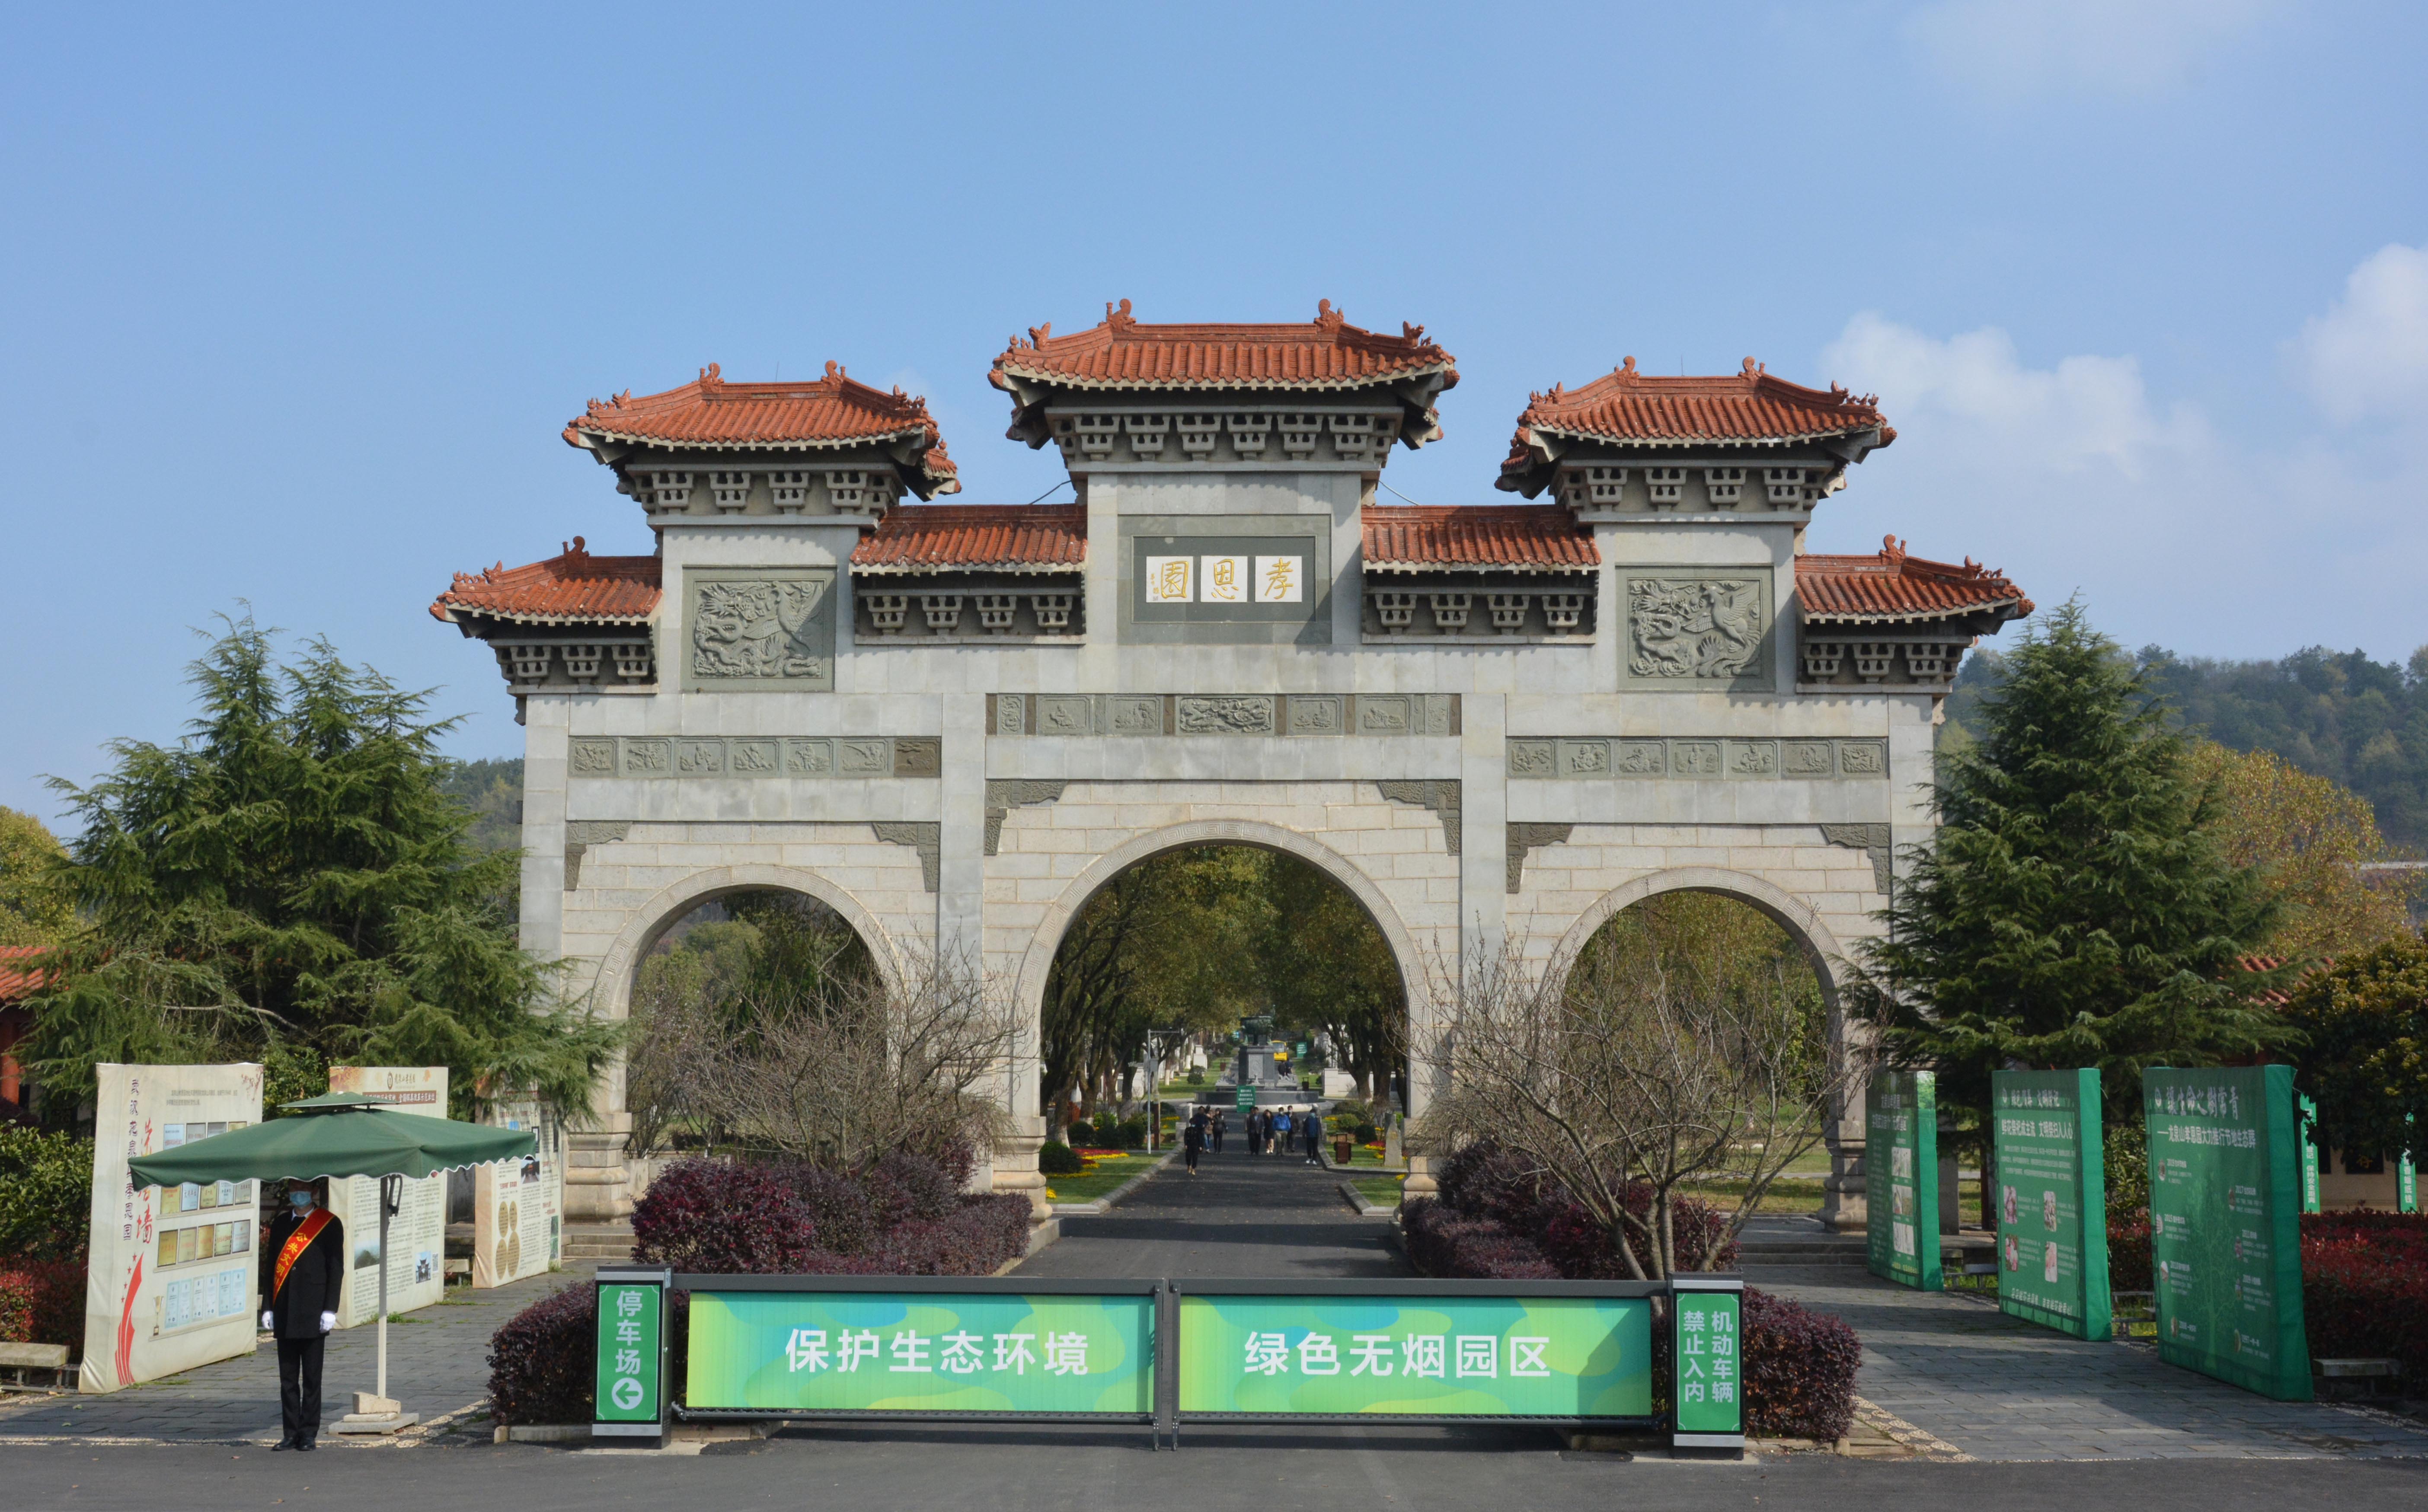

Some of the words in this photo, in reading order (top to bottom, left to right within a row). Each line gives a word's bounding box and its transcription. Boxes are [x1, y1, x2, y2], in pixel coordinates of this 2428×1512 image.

[615, 1290, 642, 1375] 停车场
[785, 1328, 1088, 1375] 保护生态环境
[1244, 1331, 1550, 1378] 绿色无烟园区
[1684, 1311, 1705, 1403] 禁止入内
[1711, 1311, 1733, 1403] 机动车辆
